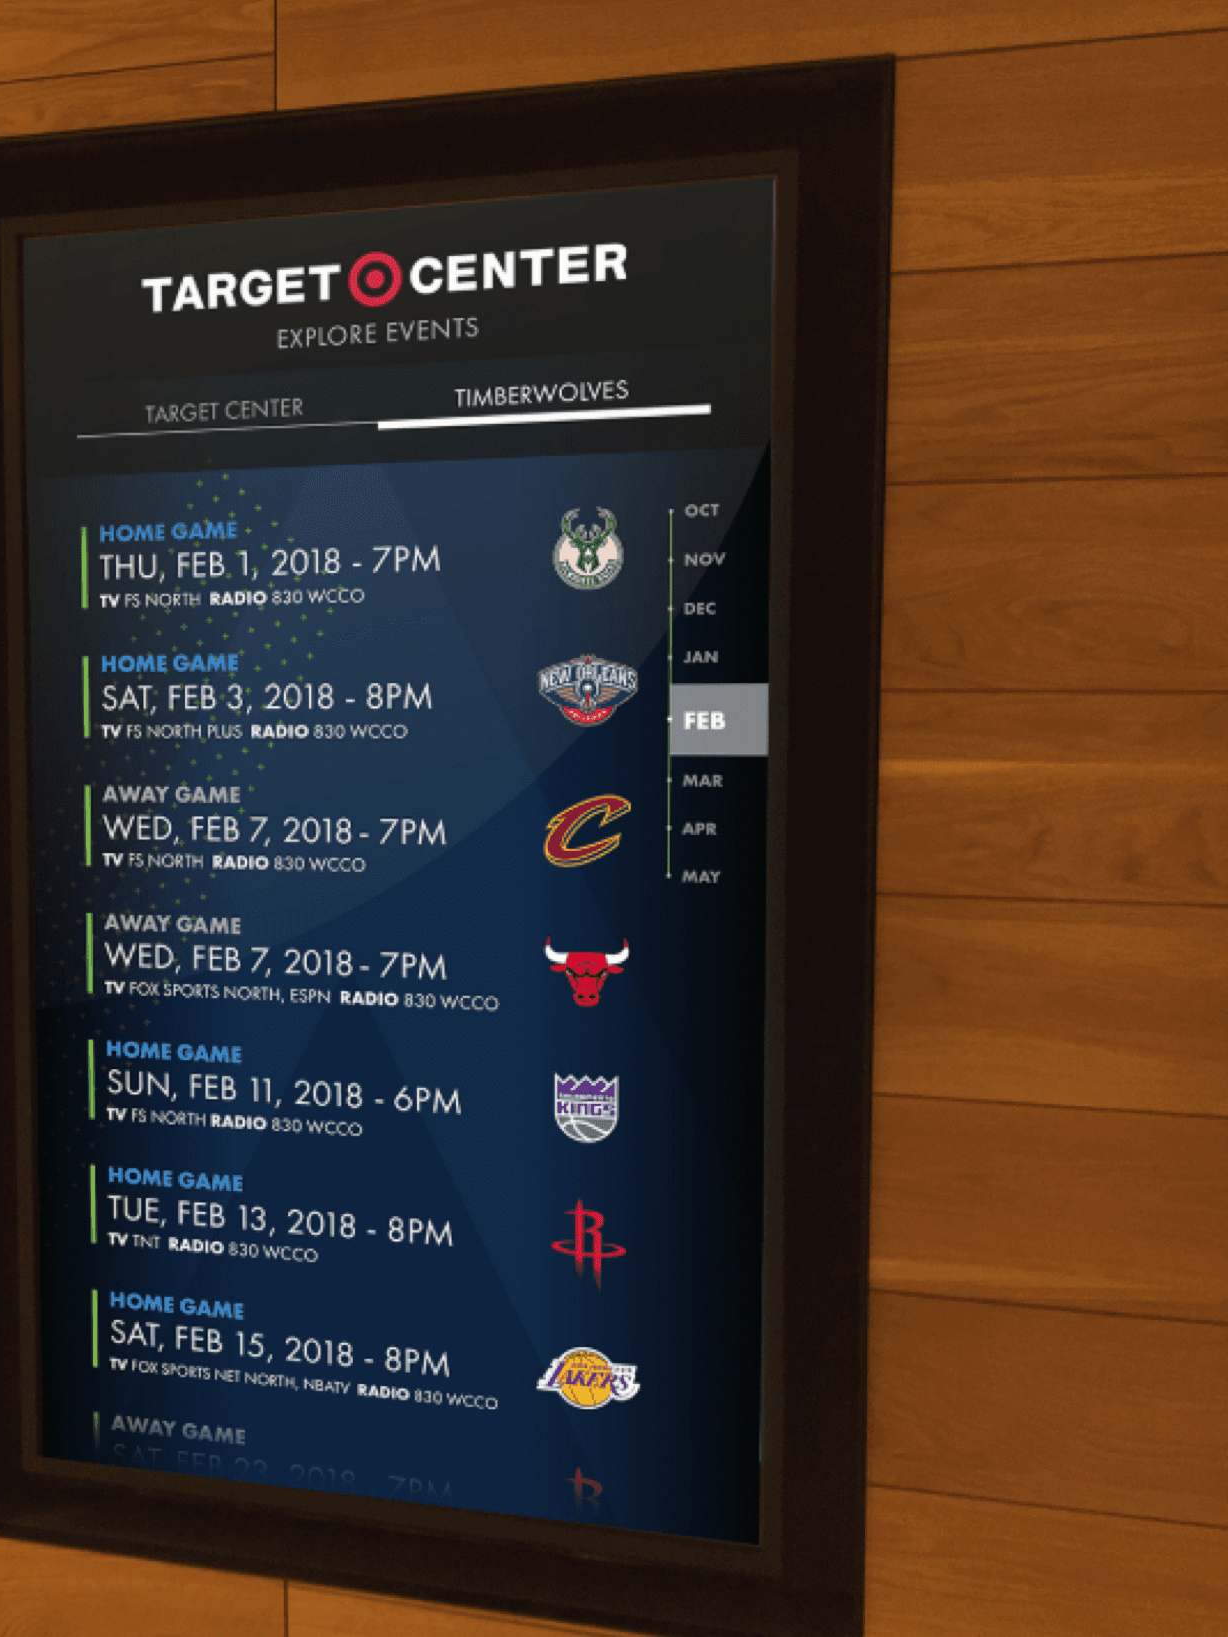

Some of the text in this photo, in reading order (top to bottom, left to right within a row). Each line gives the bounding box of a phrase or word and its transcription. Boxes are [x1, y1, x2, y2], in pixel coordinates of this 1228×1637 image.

[141, 244, 626, 312] TARGET CENTER
[278, 318, 479, 348] EXPLORE EVENTS
[454, 380, 629, 407] TIMBERWOLVES
[146, 398, 302, 423] TARGET CENTER
[685, 504, 719, 517] OCT
[100, 521, 236, 541] HOME GAME
[100, 546, 440, 583] THU, FEB 1, 2018 7PM
[685, 552, 725, 566] NOV
[100, 589, 364, 608] TV FS NORTH RADIO 830 WCCO
[684, 603, 716, 615] DEC
[102, 654, 238, 672] HOME GAME
[684, 651, 718, 663] JAN
[540, 668, 572, 690] NEW
[102, 683, 431, 715] SAT, FEB 3, 2018 8PM
[102, 724, 408, 739] TV FS NORTH PLUS RADIO 830 WCCO
[685, 711, 725, 729] FEB
[683, 775, 722, 787] MAR
[103, 786, 240, 803] AWAY GAME
[103, 815, 445, 847] WED, FEB 7, 2018 7PM
[682, 823, 716, 835] APR
[102, 853, 365, 872] TV FS NORTH RADIO 830 WCCO
[682, 871, 720, 883] MAY
[105, 914, 241, 934] AWAY GAME
[105, 943, 446, 980] WED, FEB 7, 2018 7PM
[105, 981, 500, 1012] TV FOX SPORTS NORTH, ESPN RADIO 830 WCCO
[107, 1041, 241, 1063] HOME GAME
[108, 1069, 461, 1113] SUN, FEB 11, 2018 6PM
[556, 1099, 616, 1117] KINGS
[107, 1108, 362, 1136] TV FS NORTH RADIO 830 WCCO
[109, 1166, 242, 1191] HOME GAME
[108, 1195, 452, 1246] TUE, FEB 13, 2018 8PM
[109, 1232, 318, 1262] TV TNT RADIO 830 WCCO
[111, 1292, 243, 1320] HOME GAME
[111, 1320, 449, 1377] SAT, FEB 15, 2018 8PM
[110, 1358, 498, 1409] TV FOX SPORTS NET NORTH, NBATV RADIO 830 WCCO
[112, 1415, 245, 1446] AWAY GAME
